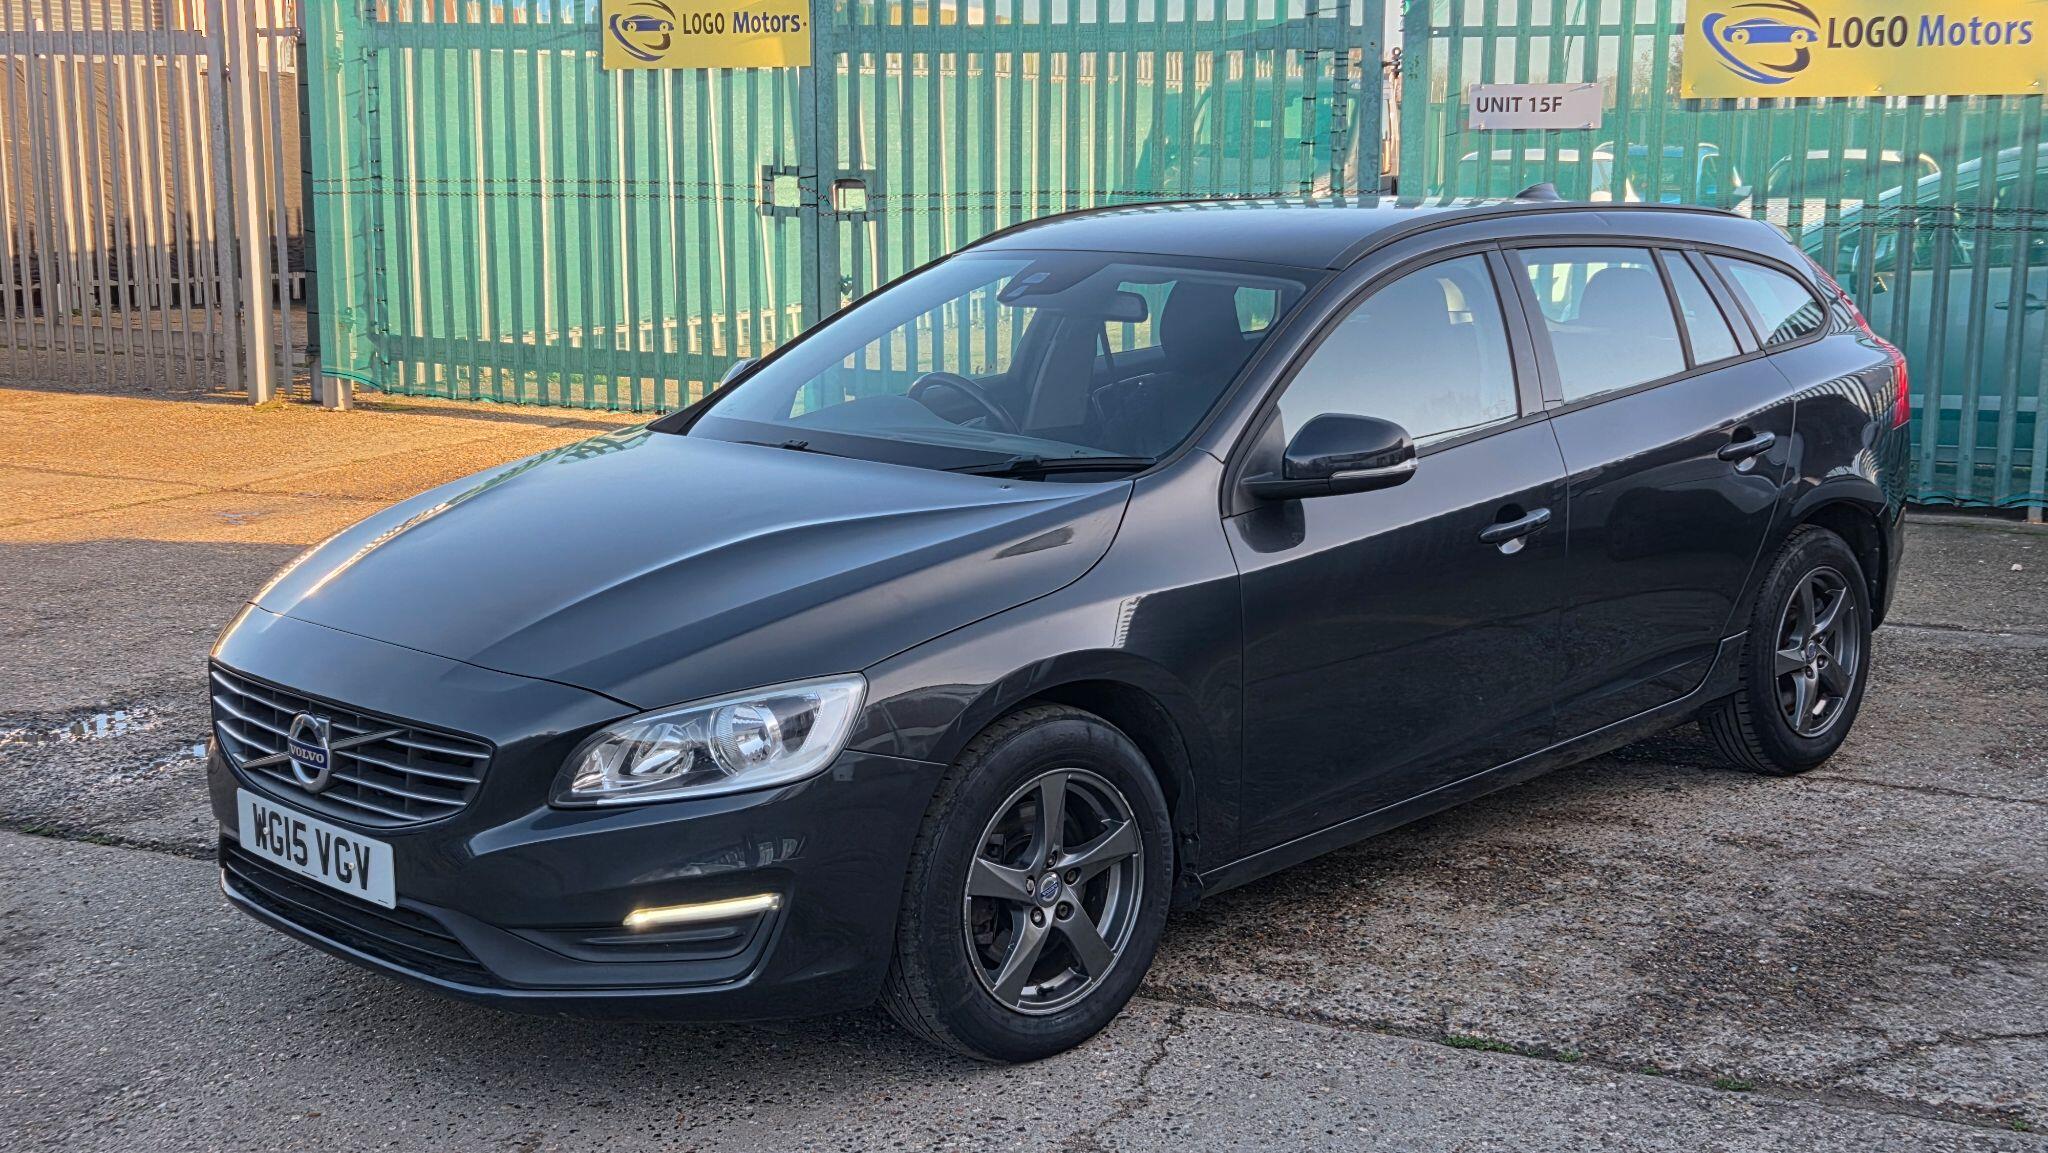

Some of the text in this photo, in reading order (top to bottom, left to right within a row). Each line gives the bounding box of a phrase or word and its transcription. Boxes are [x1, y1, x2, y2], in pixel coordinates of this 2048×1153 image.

[683, 12, 800, 34] LOGO Motors
[1827, 15, 2034, 48] LOGO Motors
[1476, 96, 1562, 113] UNIT 15F
[289, 743, 325, 763] VOLVO
[253, 803, 371, 890] WG15 VGV
